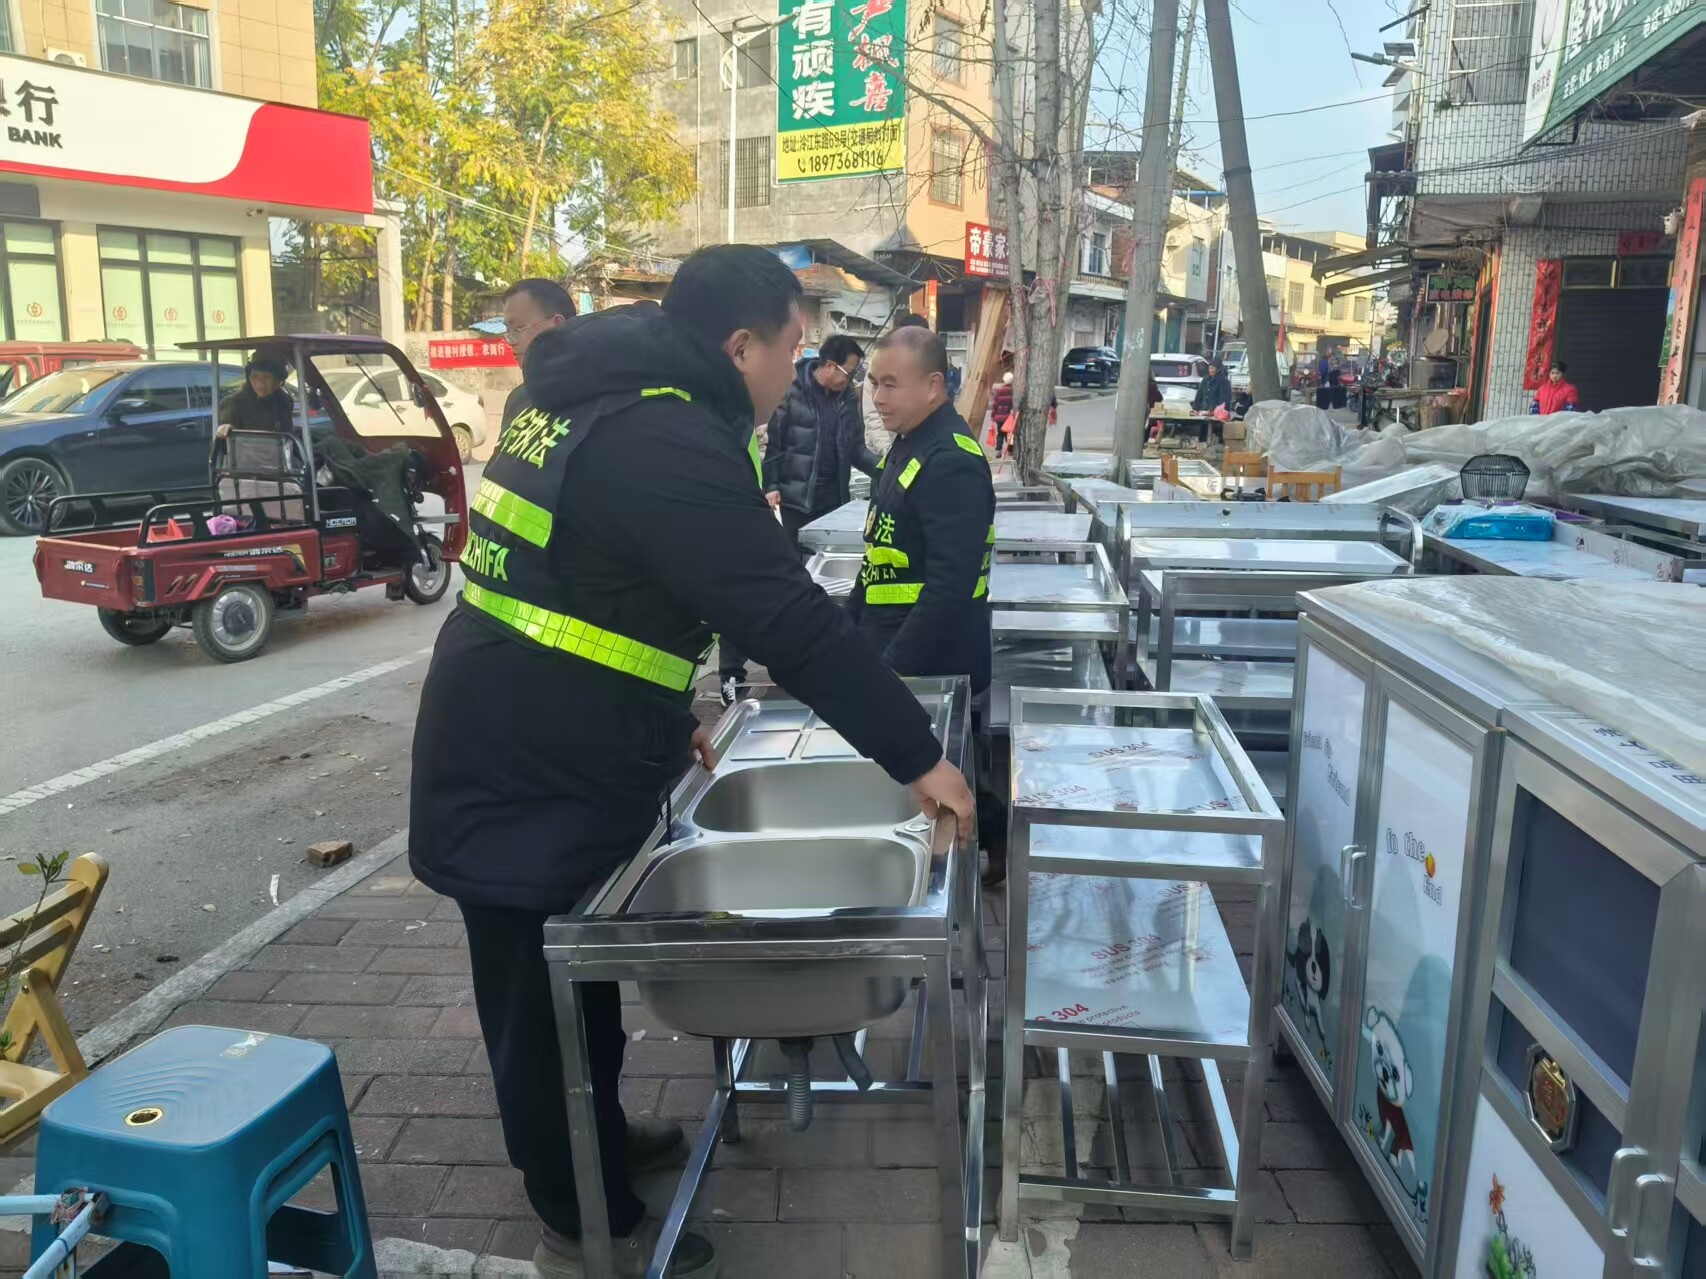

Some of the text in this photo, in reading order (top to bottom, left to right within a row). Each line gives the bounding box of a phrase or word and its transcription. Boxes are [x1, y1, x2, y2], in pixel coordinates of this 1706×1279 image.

[7, 126, 63, 149] BANK
[969, 226, 1009, 260] 帝豪家
[1091, 943, 1130, 960] SUS
[1051, 1003, 1089, 1021] 304
